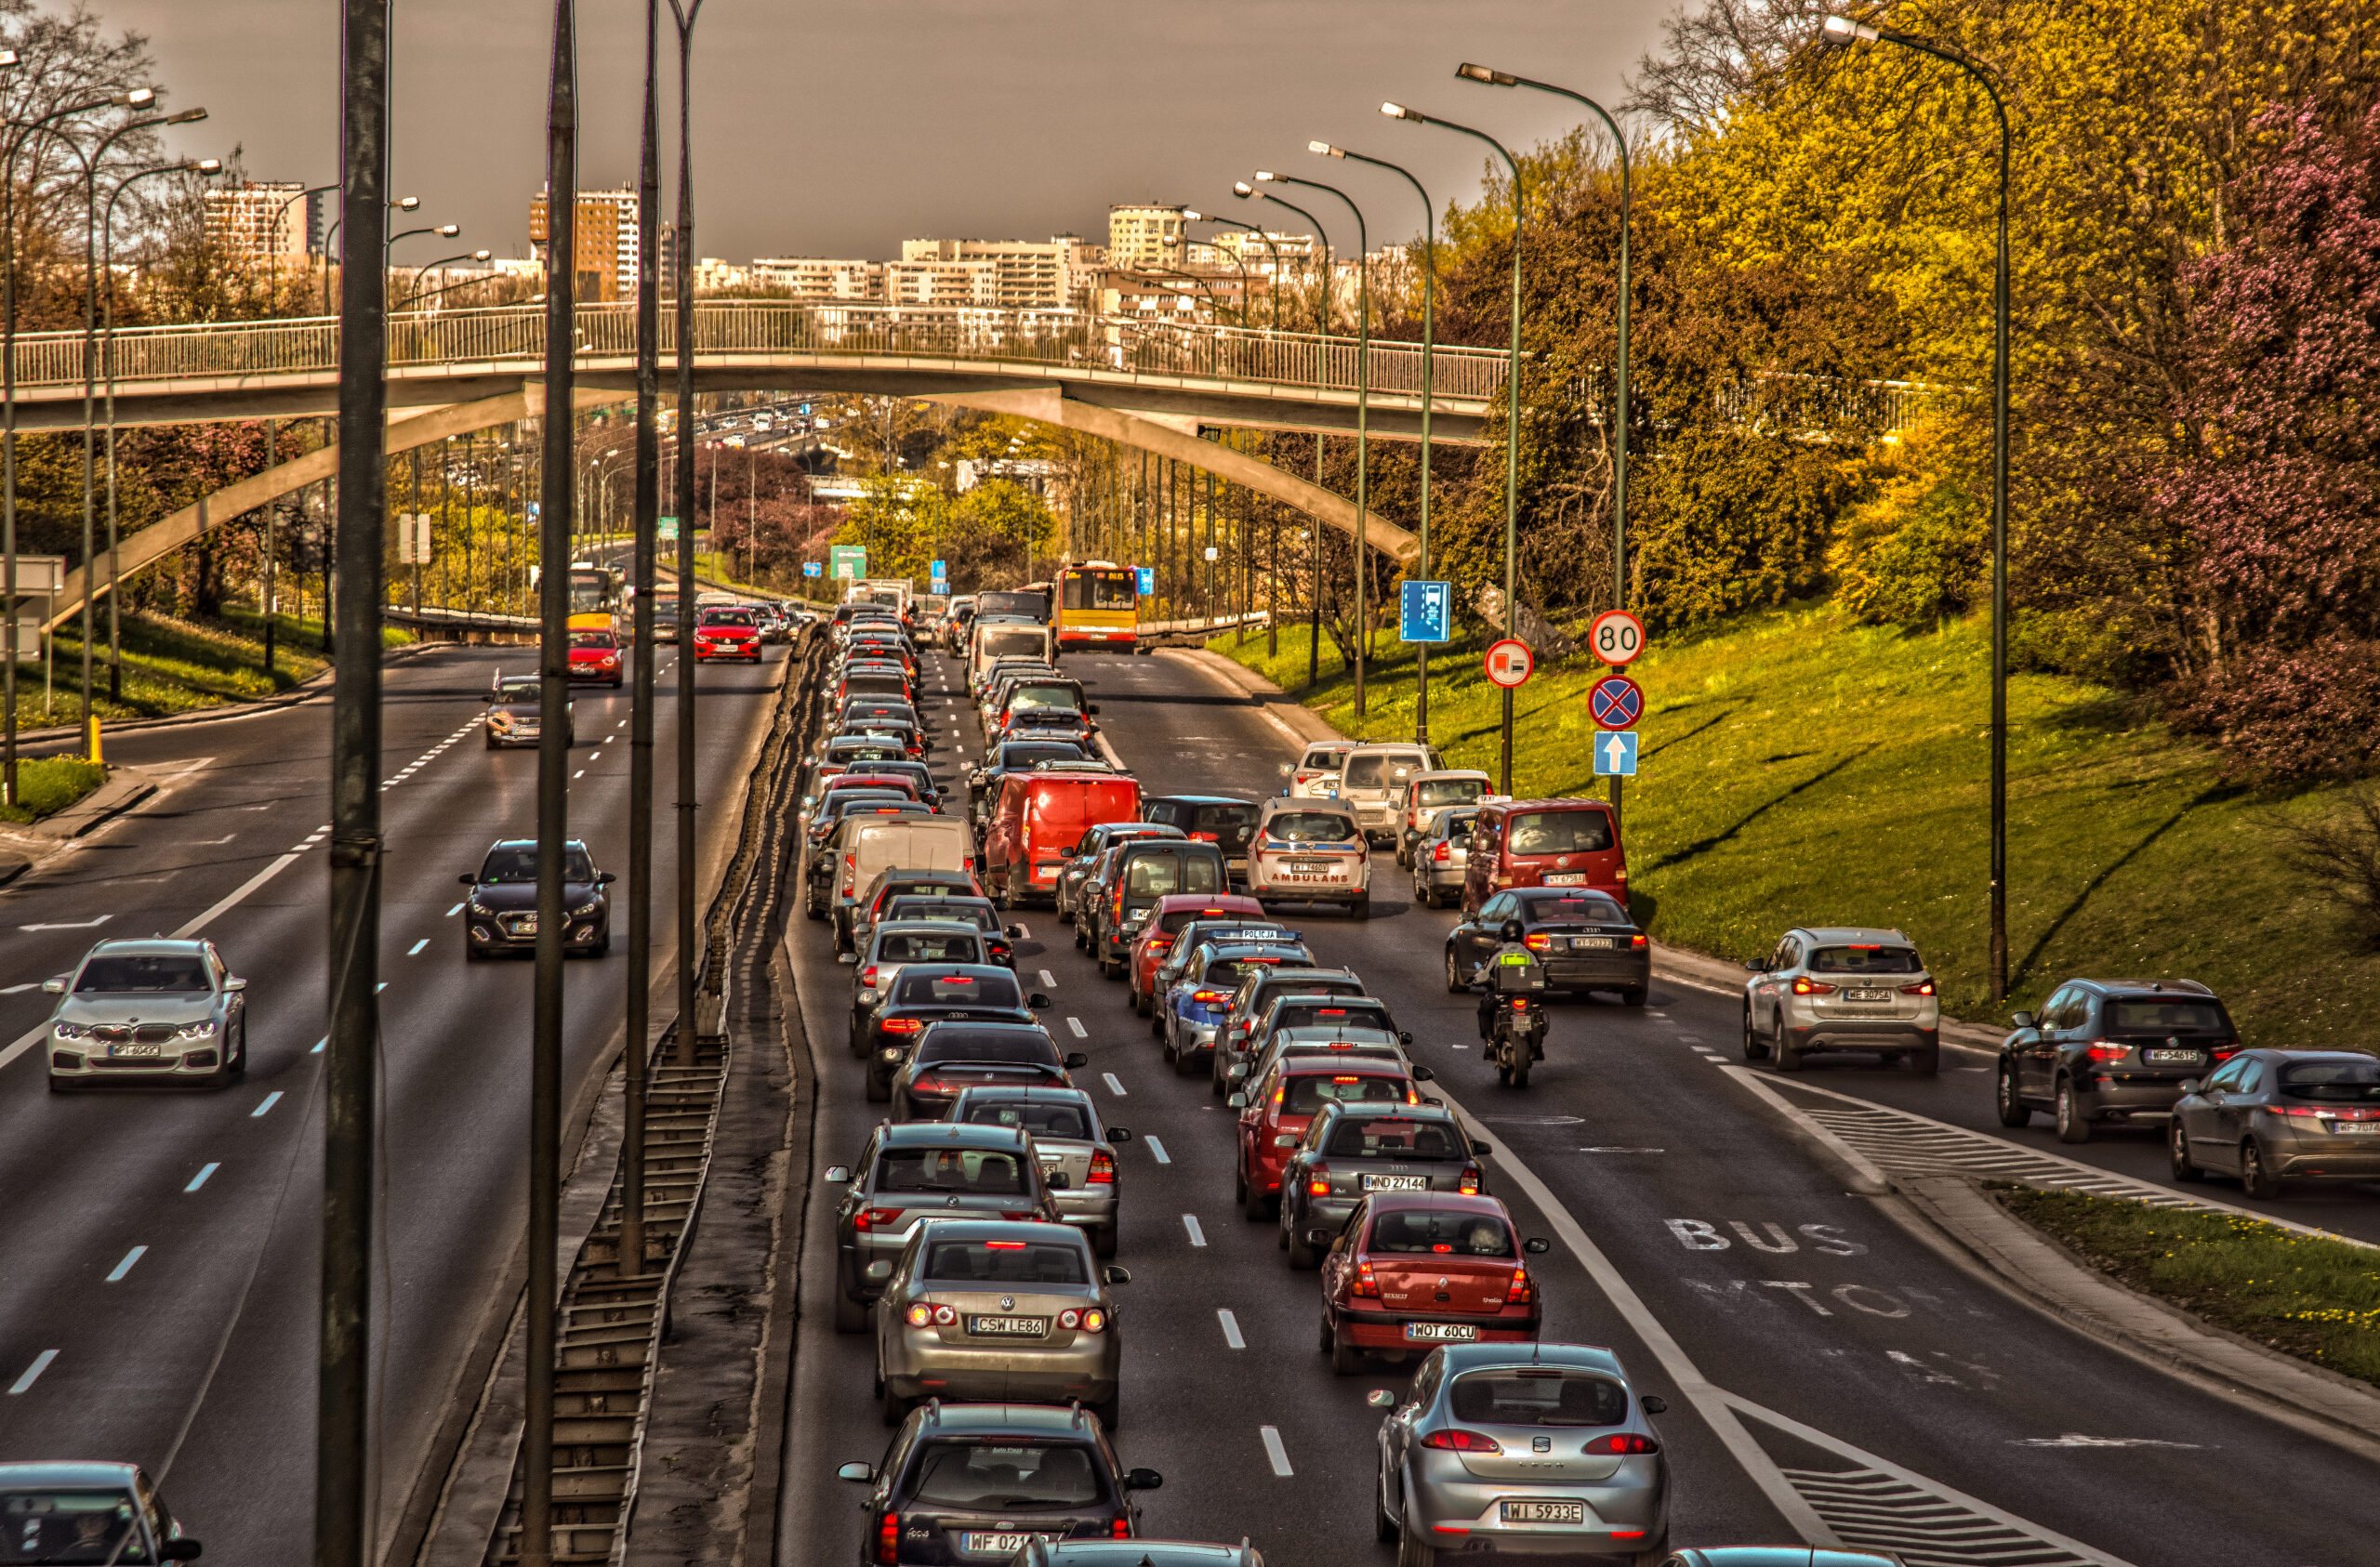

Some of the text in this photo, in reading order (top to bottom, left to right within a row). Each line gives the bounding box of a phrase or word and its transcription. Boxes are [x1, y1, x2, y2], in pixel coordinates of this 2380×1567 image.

[1599, 625, 1636, 652] 80
[1272, 873, 1348, 883] AMBULANS
[1849, 990, 1862, 999] WE
[1370, 1177, 1424, 1188] WND 27144
[1664, 1218, 1869, 1257] BUS
[979, 1318, 1040, 1333] CSW LE86
[1415, 1324, 1474, 1338] WOT 60CU
[1511, 1504, 1580, 1520] WI 5933E
[972, 1534, 994, 1549] WF
